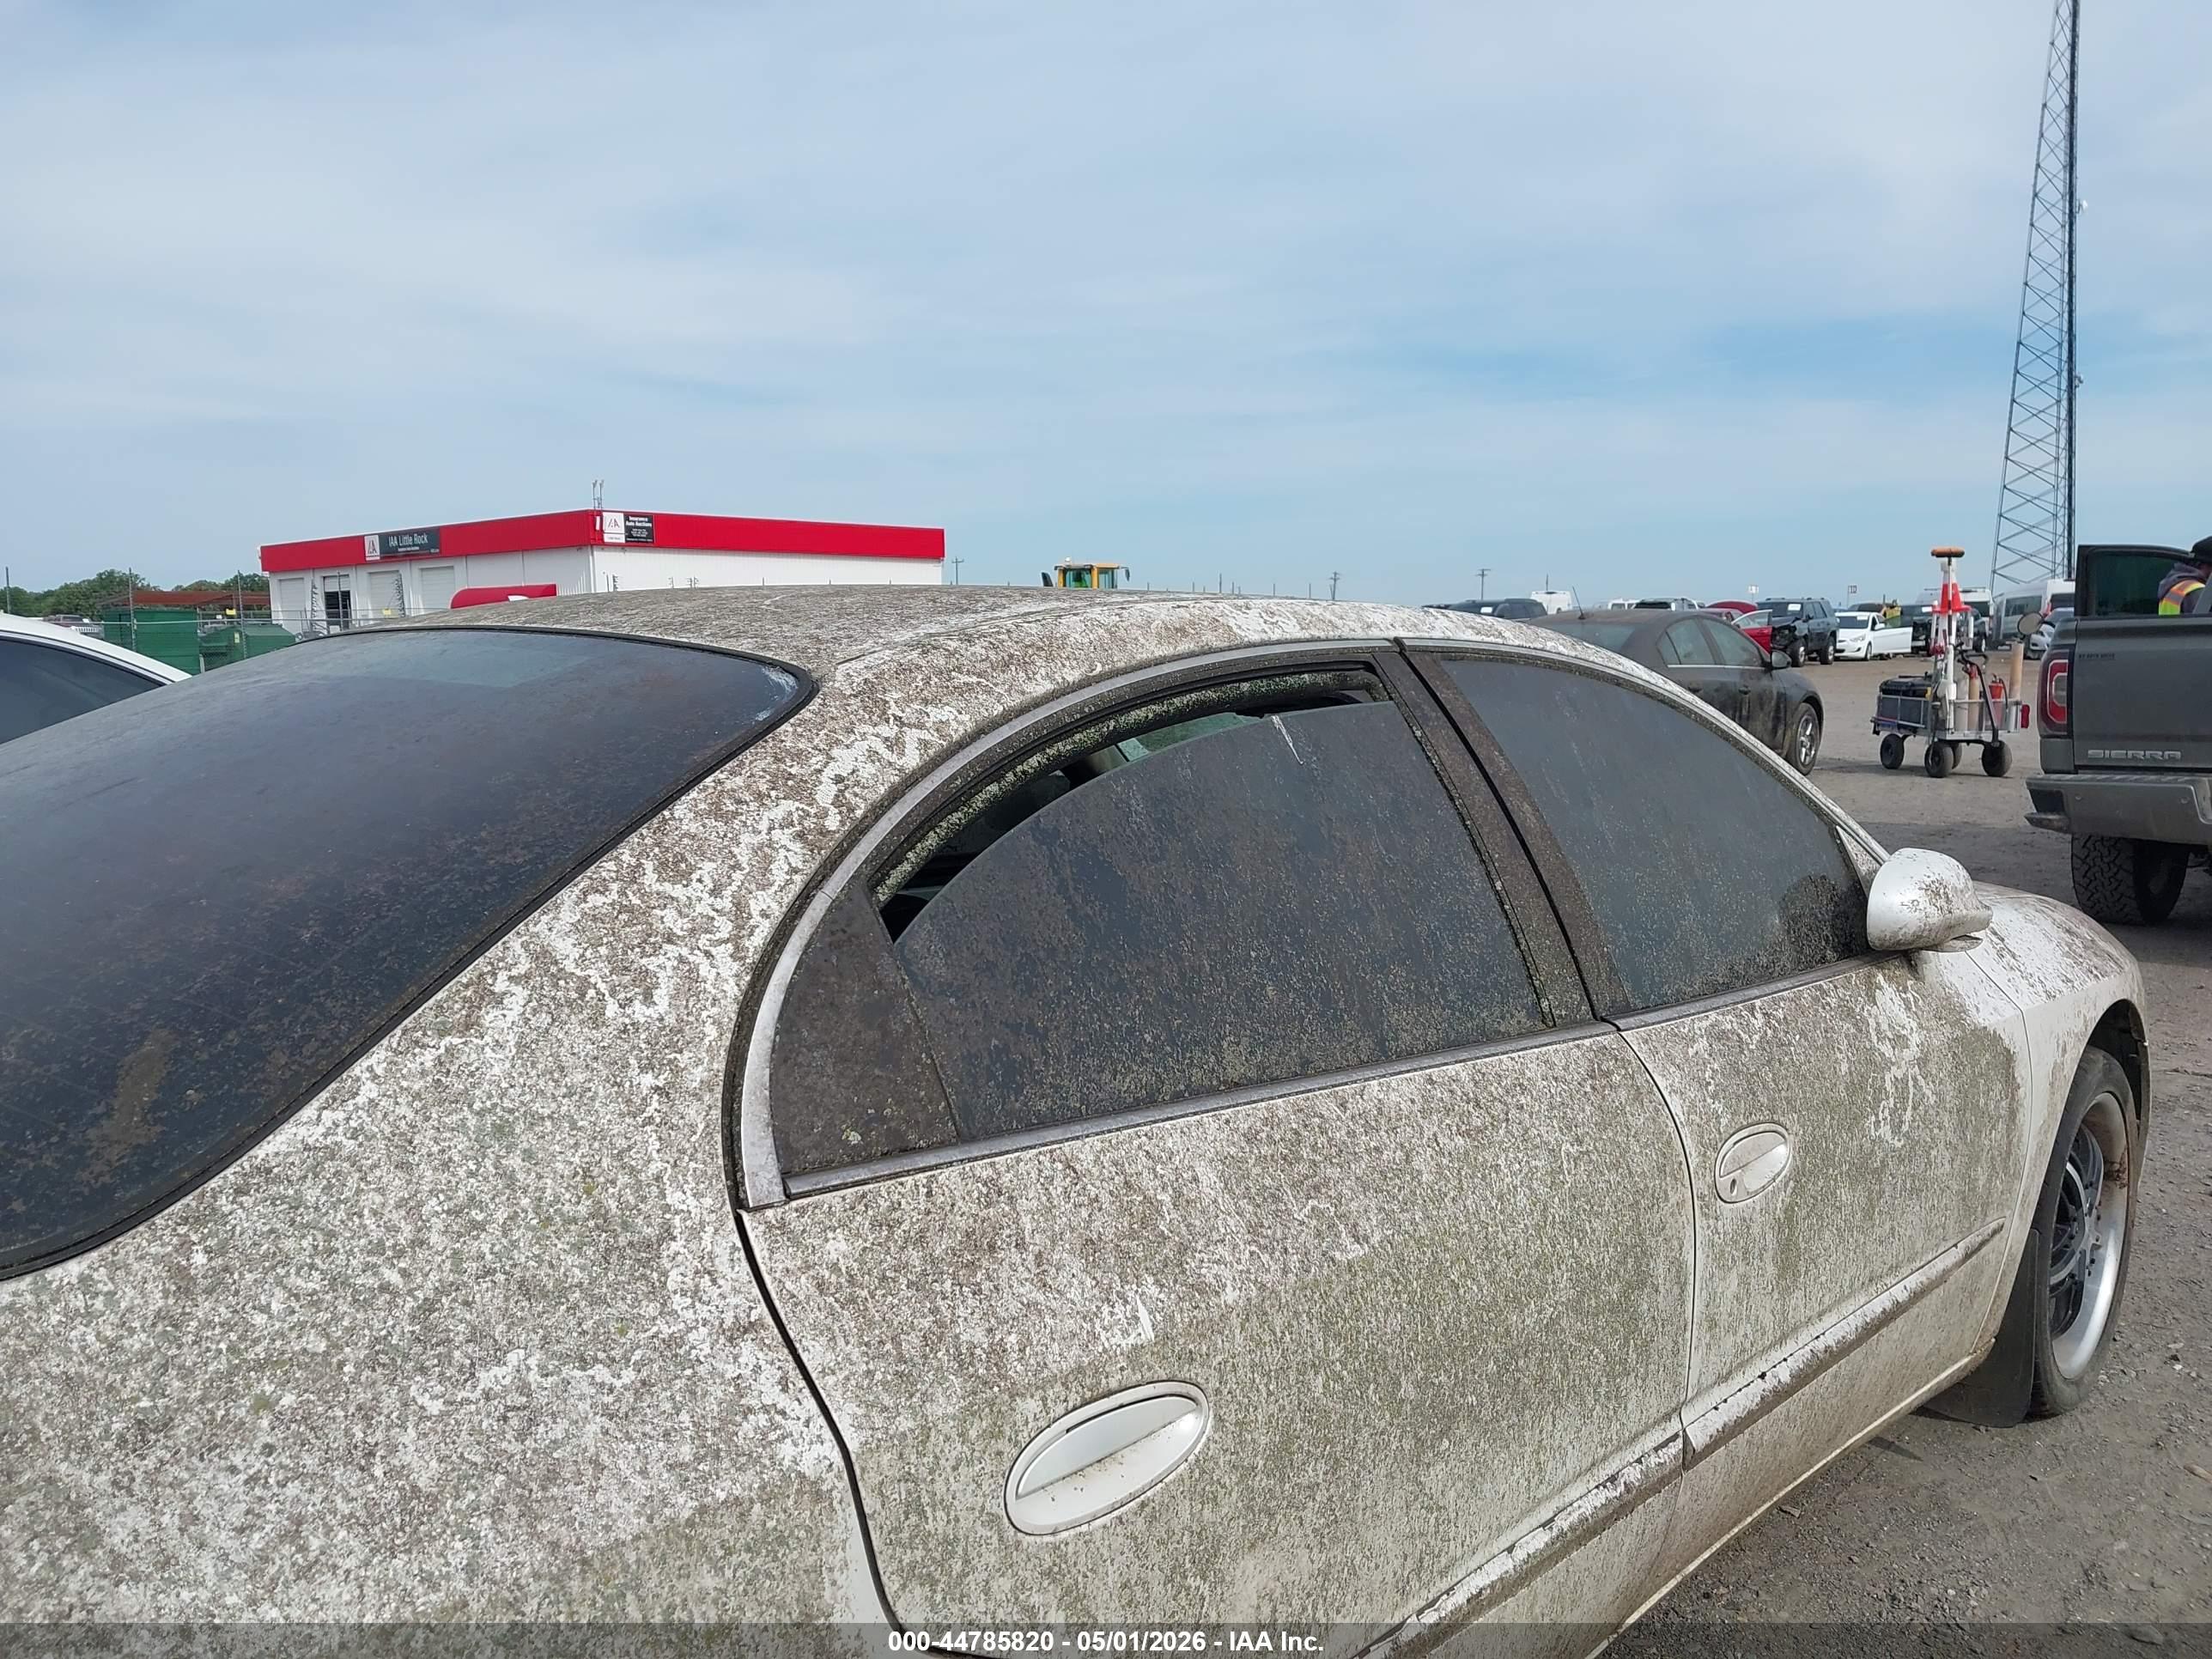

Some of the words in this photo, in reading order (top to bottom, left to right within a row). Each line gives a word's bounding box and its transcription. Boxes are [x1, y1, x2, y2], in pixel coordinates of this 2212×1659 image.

[388, 535, 398, 547] IAA
[398, 534, 413, 546] Little
[413, 532, 428, 544] Rock
[2087, 749, 2182, 761] SIERRA
